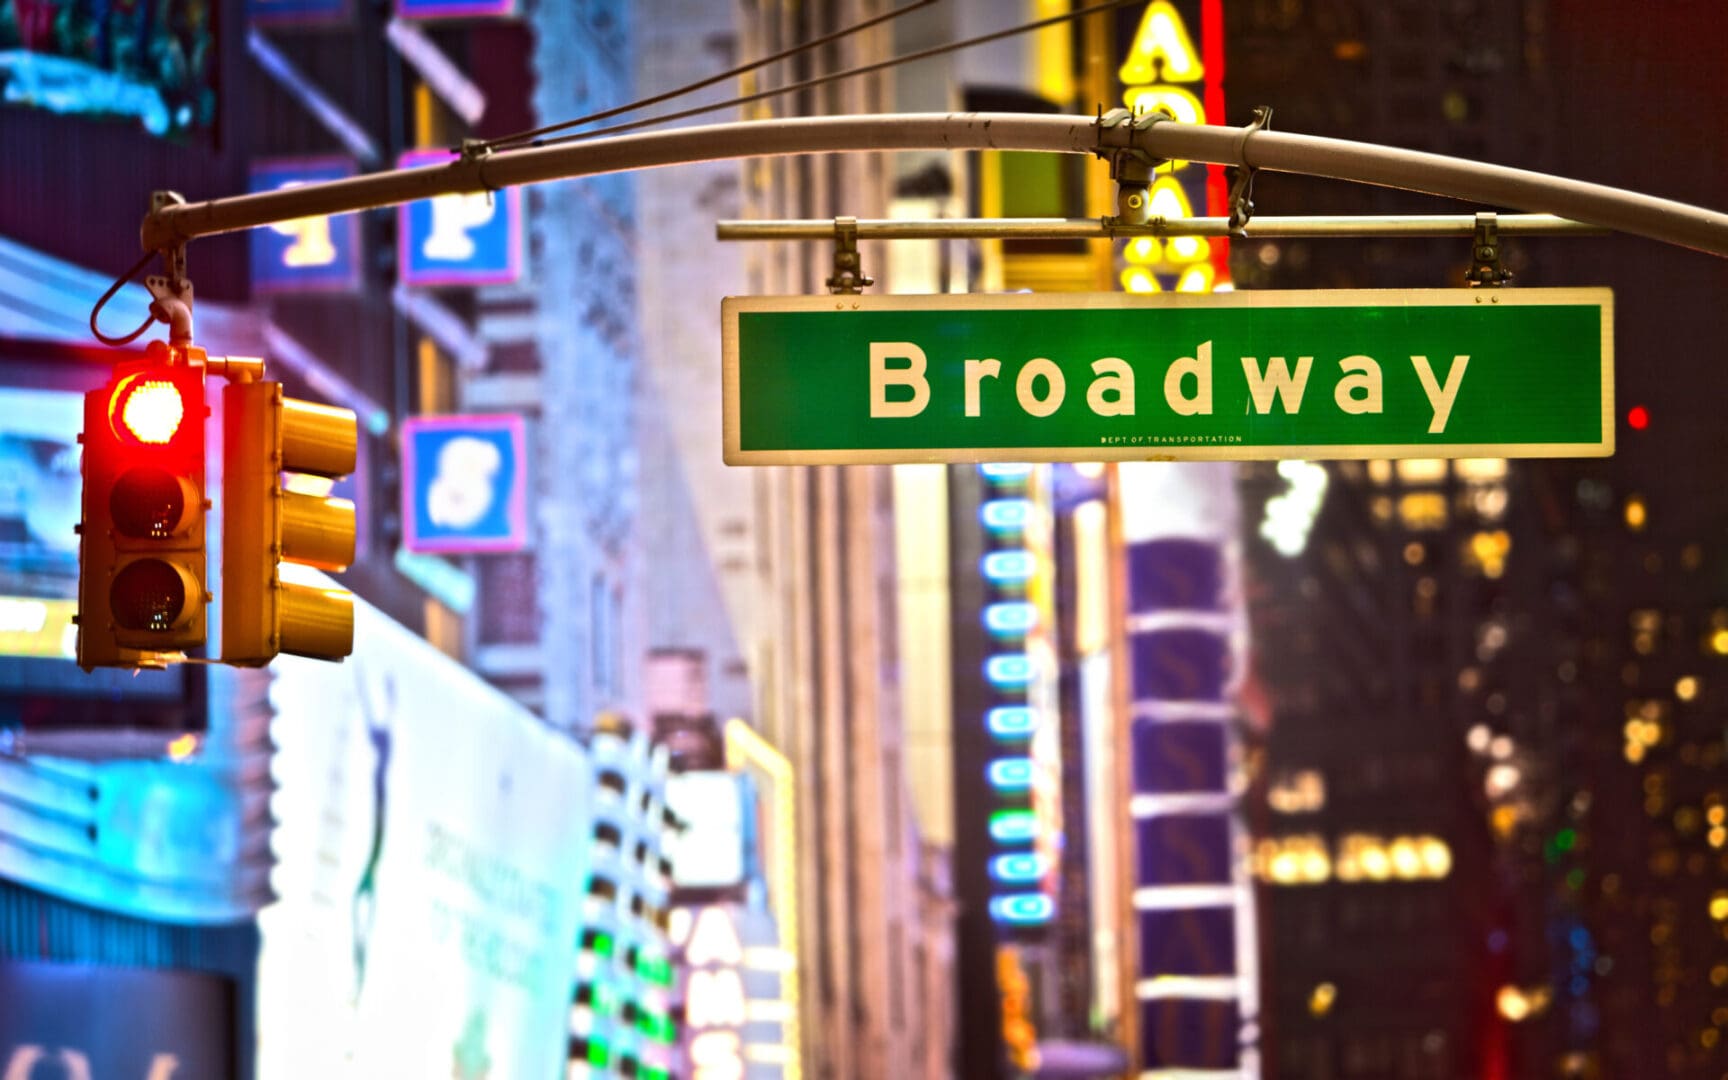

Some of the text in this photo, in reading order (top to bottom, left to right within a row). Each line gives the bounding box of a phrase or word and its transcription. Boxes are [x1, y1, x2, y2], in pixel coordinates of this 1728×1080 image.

[869, 340, 1471, 434] Broadway
[1101, 435, 1243, 444] DEPT OF TRANSPORTATION
